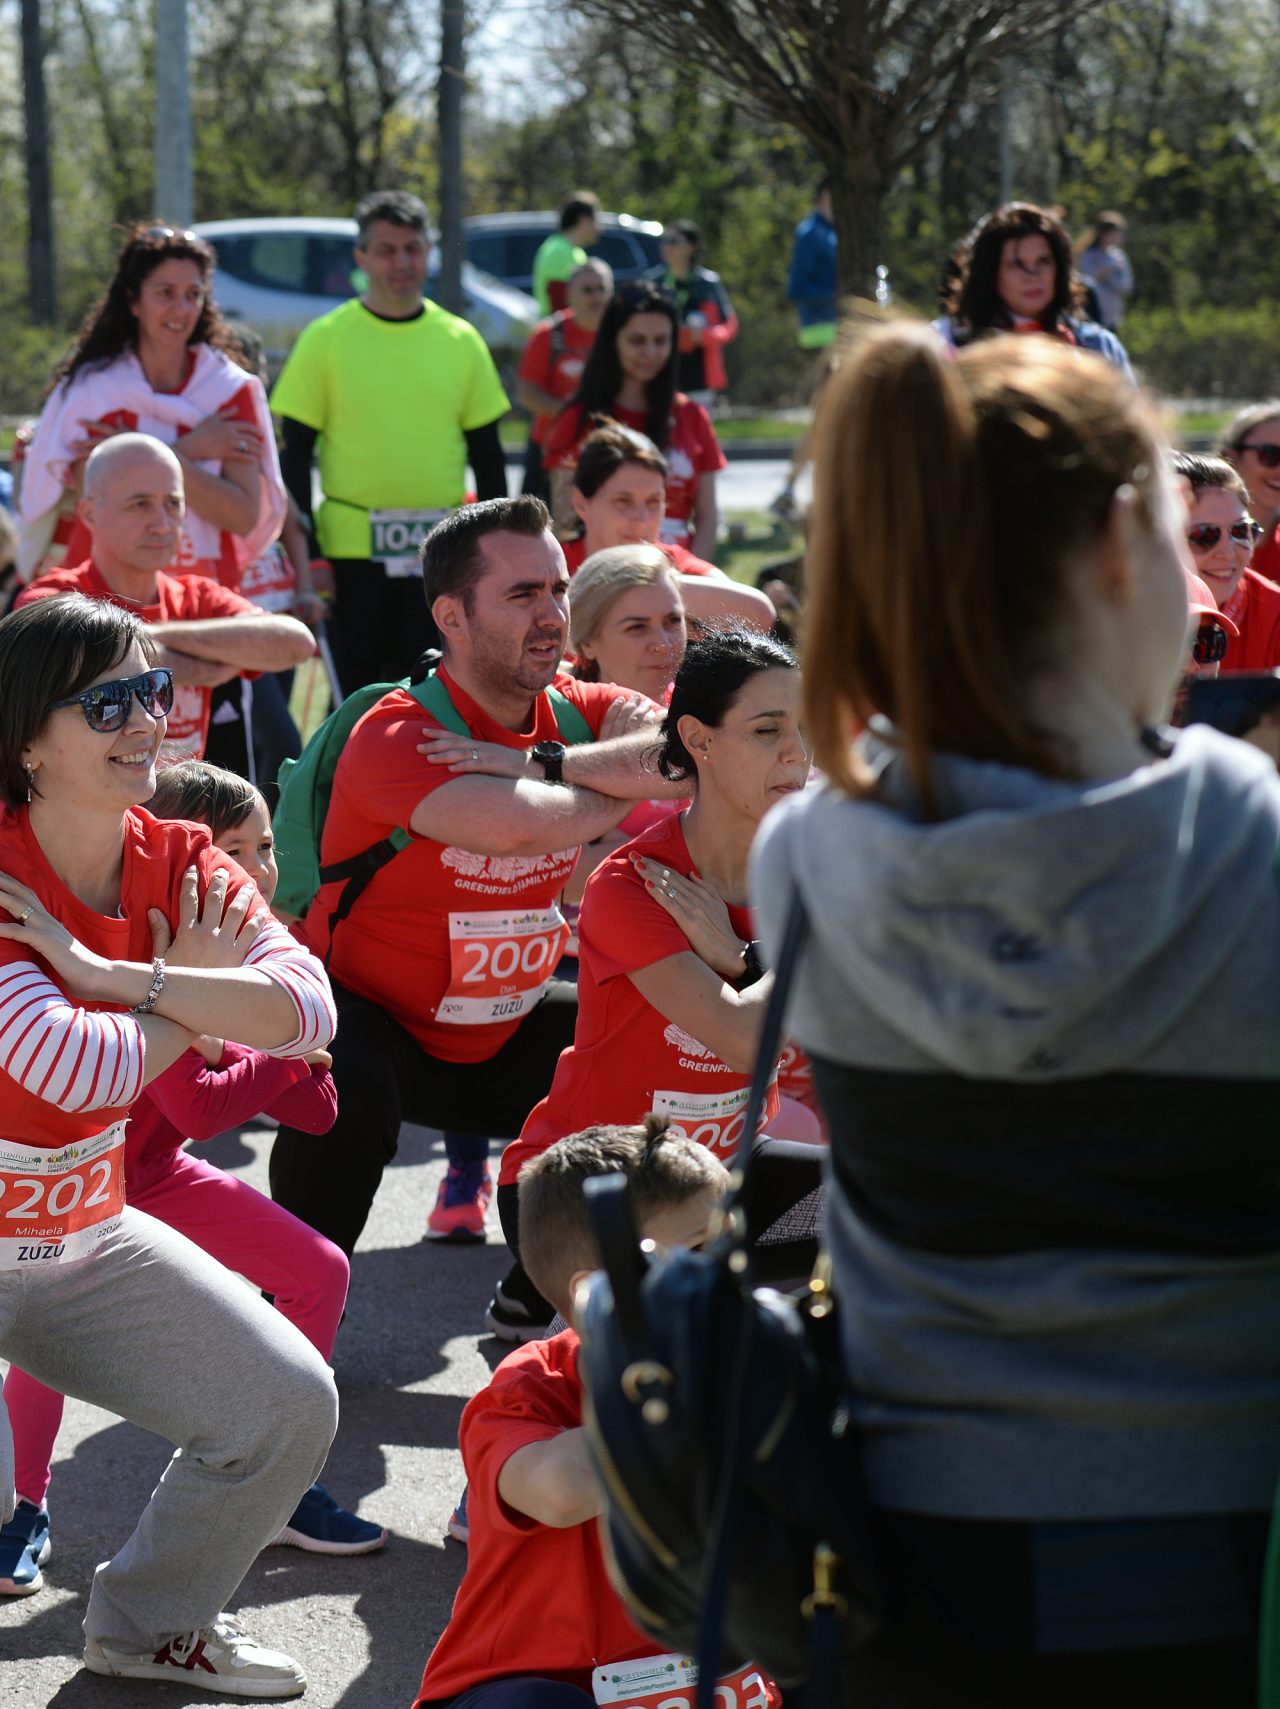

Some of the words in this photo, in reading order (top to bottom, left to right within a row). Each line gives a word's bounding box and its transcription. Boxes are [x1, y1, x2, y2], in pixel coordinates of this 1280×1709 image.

[454, 878, 520, 896] GREENFIELD
[517, 872, 550, 891] FAMILY
[550, 864, 573, 880] RUN
[462, 930, 561, 983] 2001
[500, 985, 517, 994] Dan
[491, 1000, 524, 1017] ZUZU
[15, 1226, 64, 1236] Mihaela
[17, 1244, 66, 1261] ZUZU
